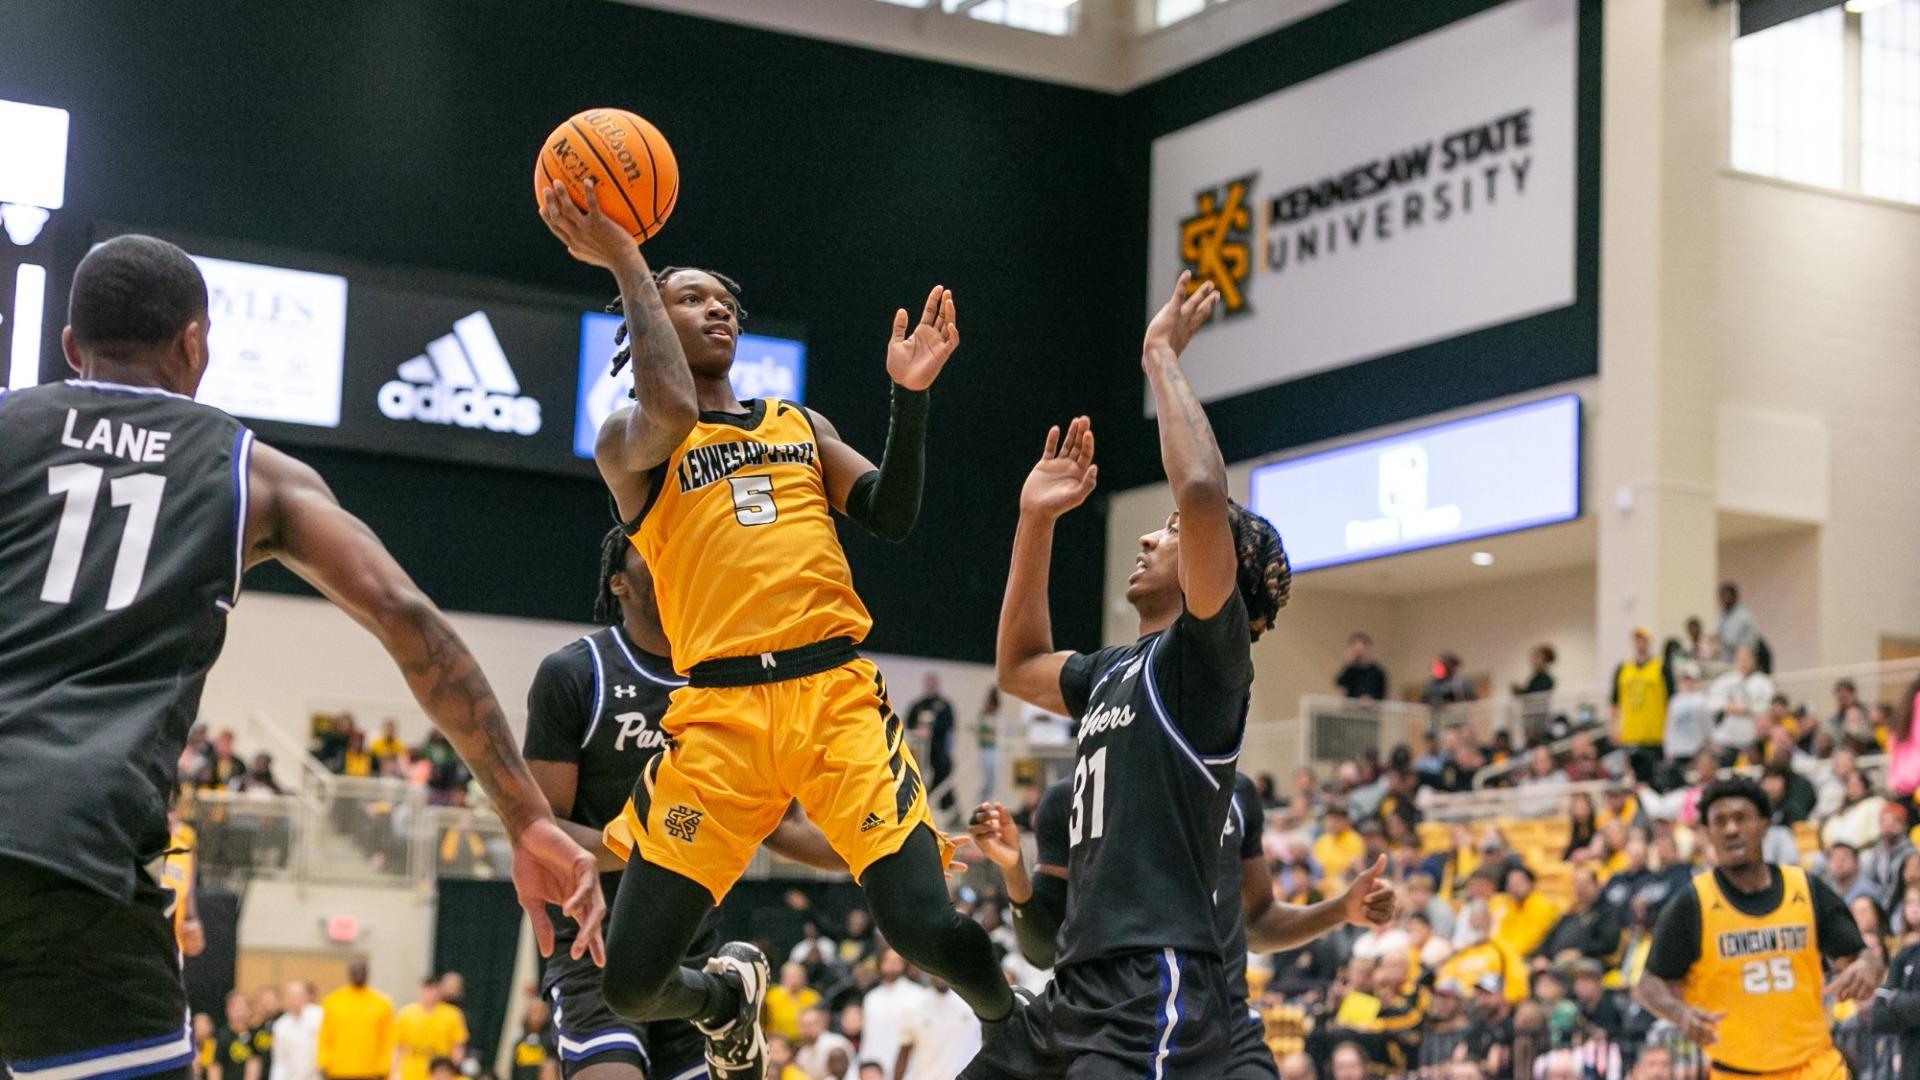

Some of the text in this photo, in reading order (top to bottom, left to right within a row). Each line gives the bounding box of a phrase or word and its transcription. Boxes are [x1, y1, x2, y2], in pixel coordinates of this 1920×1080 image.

[583, 111, 642, 184] Wilson
[1268, 108, 1533, 225] KENNESAW STATE
[1268, 158, 1533, 272] UNIVERSITY
[61, 407, 172, 463] LANE
[377, 379, 543, 436] adidas
[677, 441, 815, 495] KENNESAW STATE
[727, 474, 779, 528] 5
[39, 462, 168, 611] 11
[1069, 746, 1107, 849] 31
[1718, 925, 1808, 958] KENNESAW STATE
[1742, 956, 1796, 995] 25
